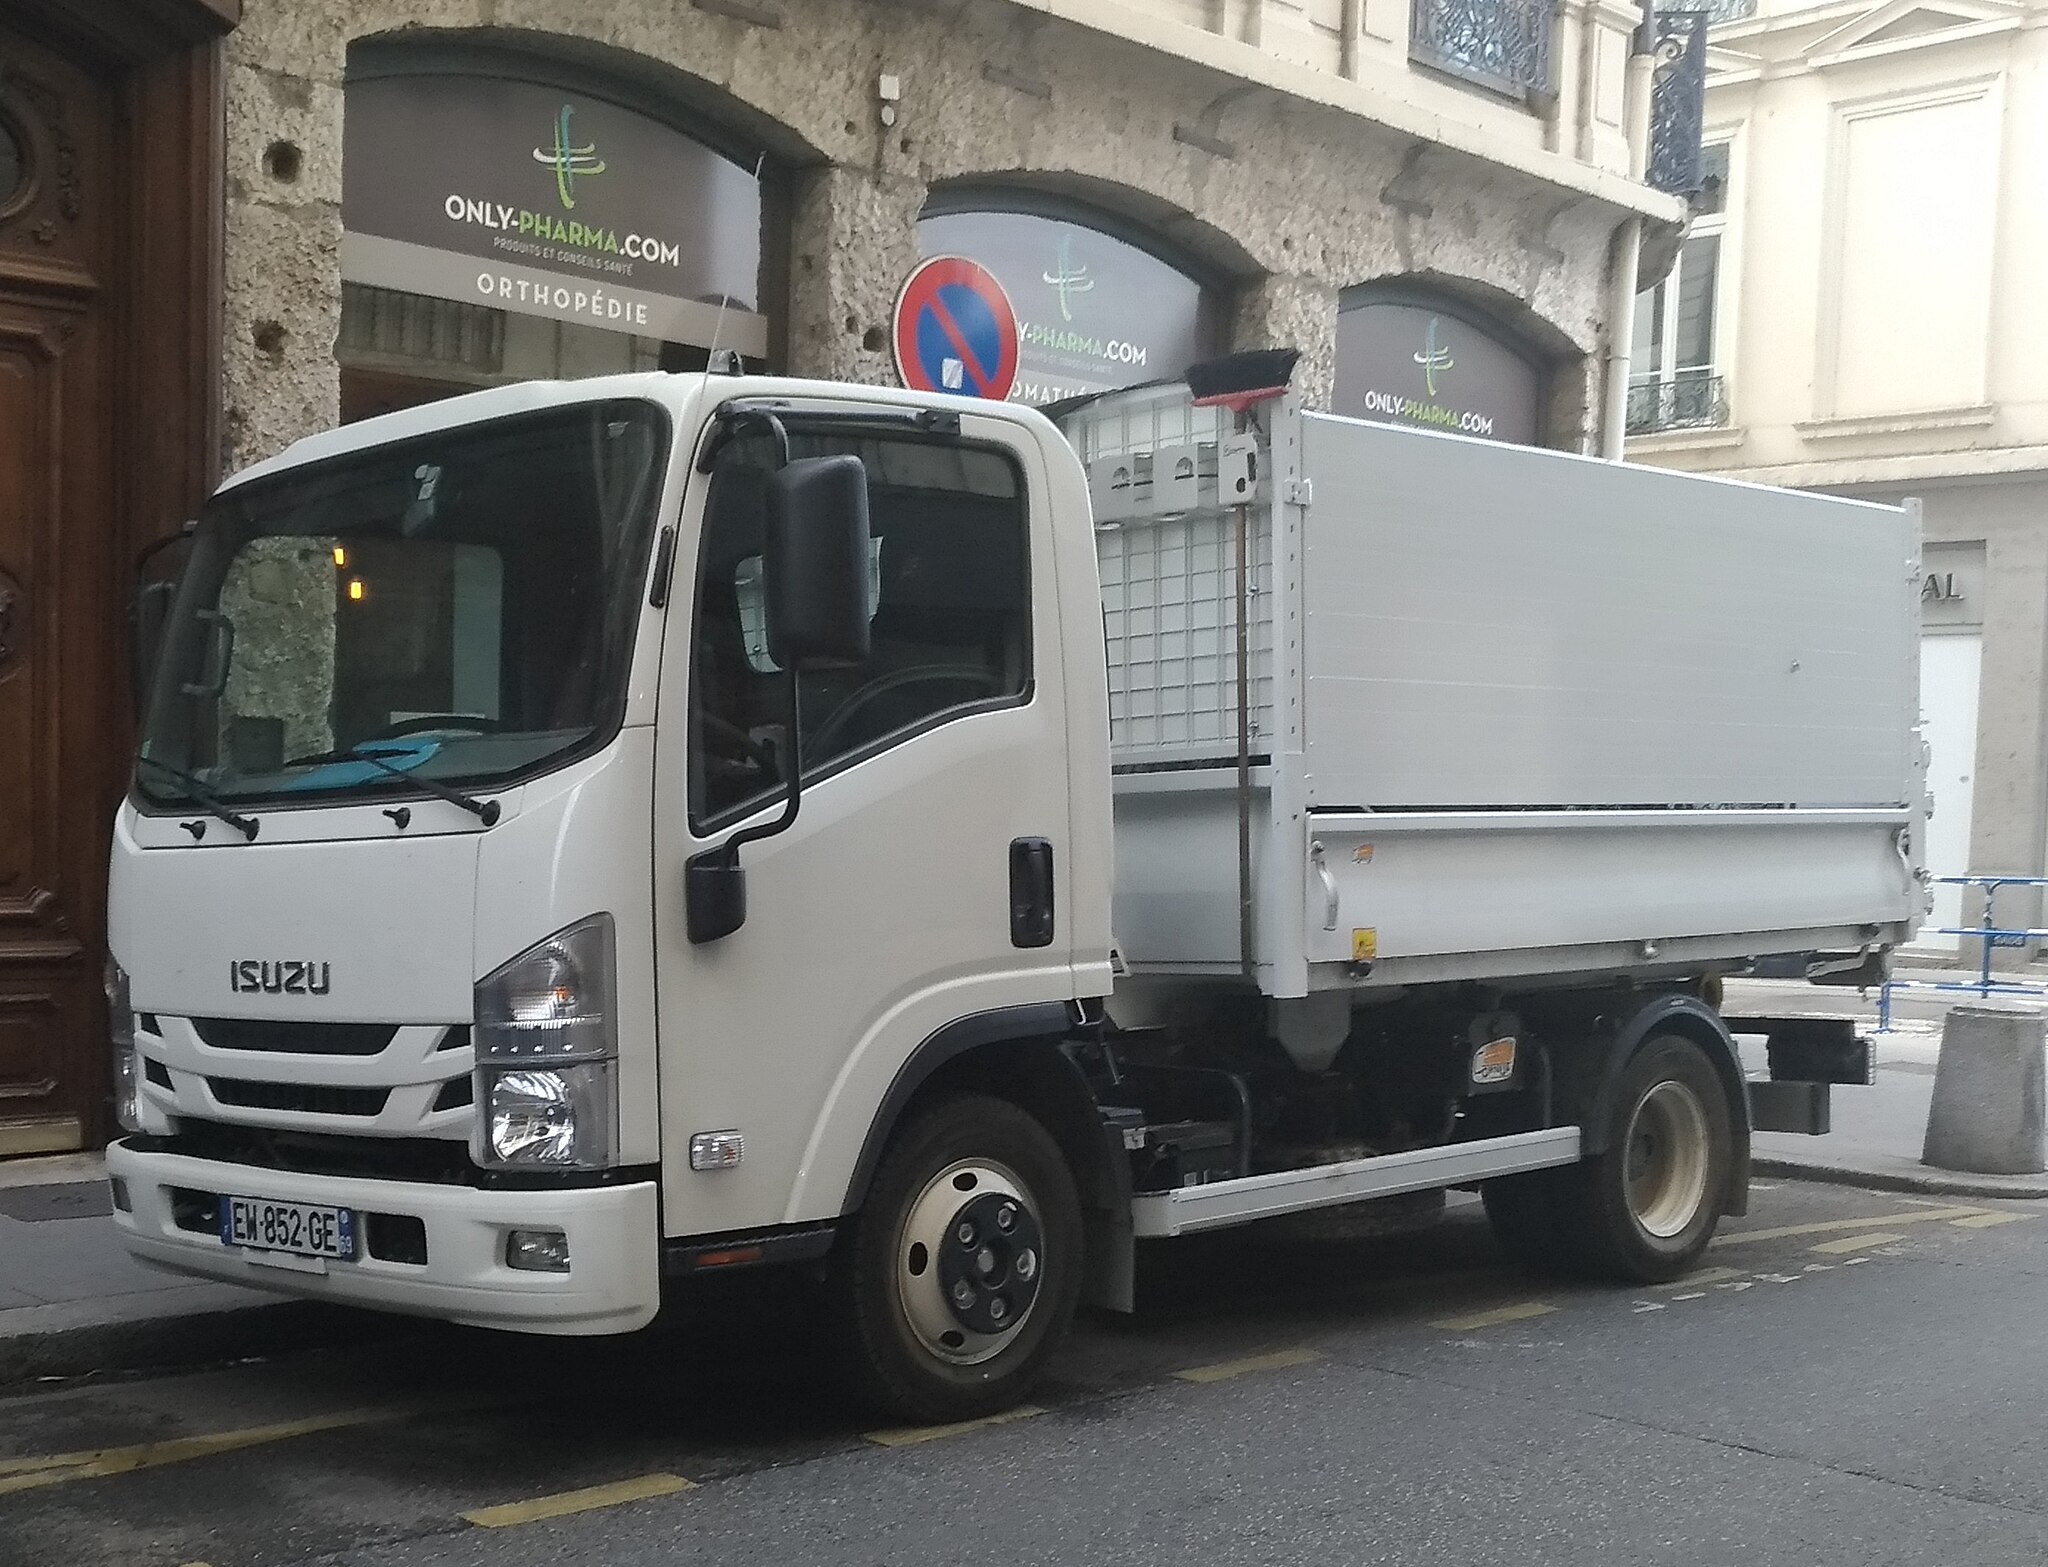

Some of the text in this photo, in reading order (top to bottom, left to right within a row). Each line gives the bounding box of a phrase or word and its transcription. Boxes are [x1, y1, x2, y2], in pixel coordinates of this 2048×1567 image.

[444, 194, 680, 267] ONLY-PHARMA.COM
[543, 247, 555, 259] ET
[476, 273, 648, 325] ORTHOPÉDIE
[1364, 390, 1494, 436] ONLY-PHARMA.COM
[230, 959, 330, 995] ISUZU
[232, 1201, 338, 1253] EW-852-GE
[339, 1235, 353, 1254] 69
